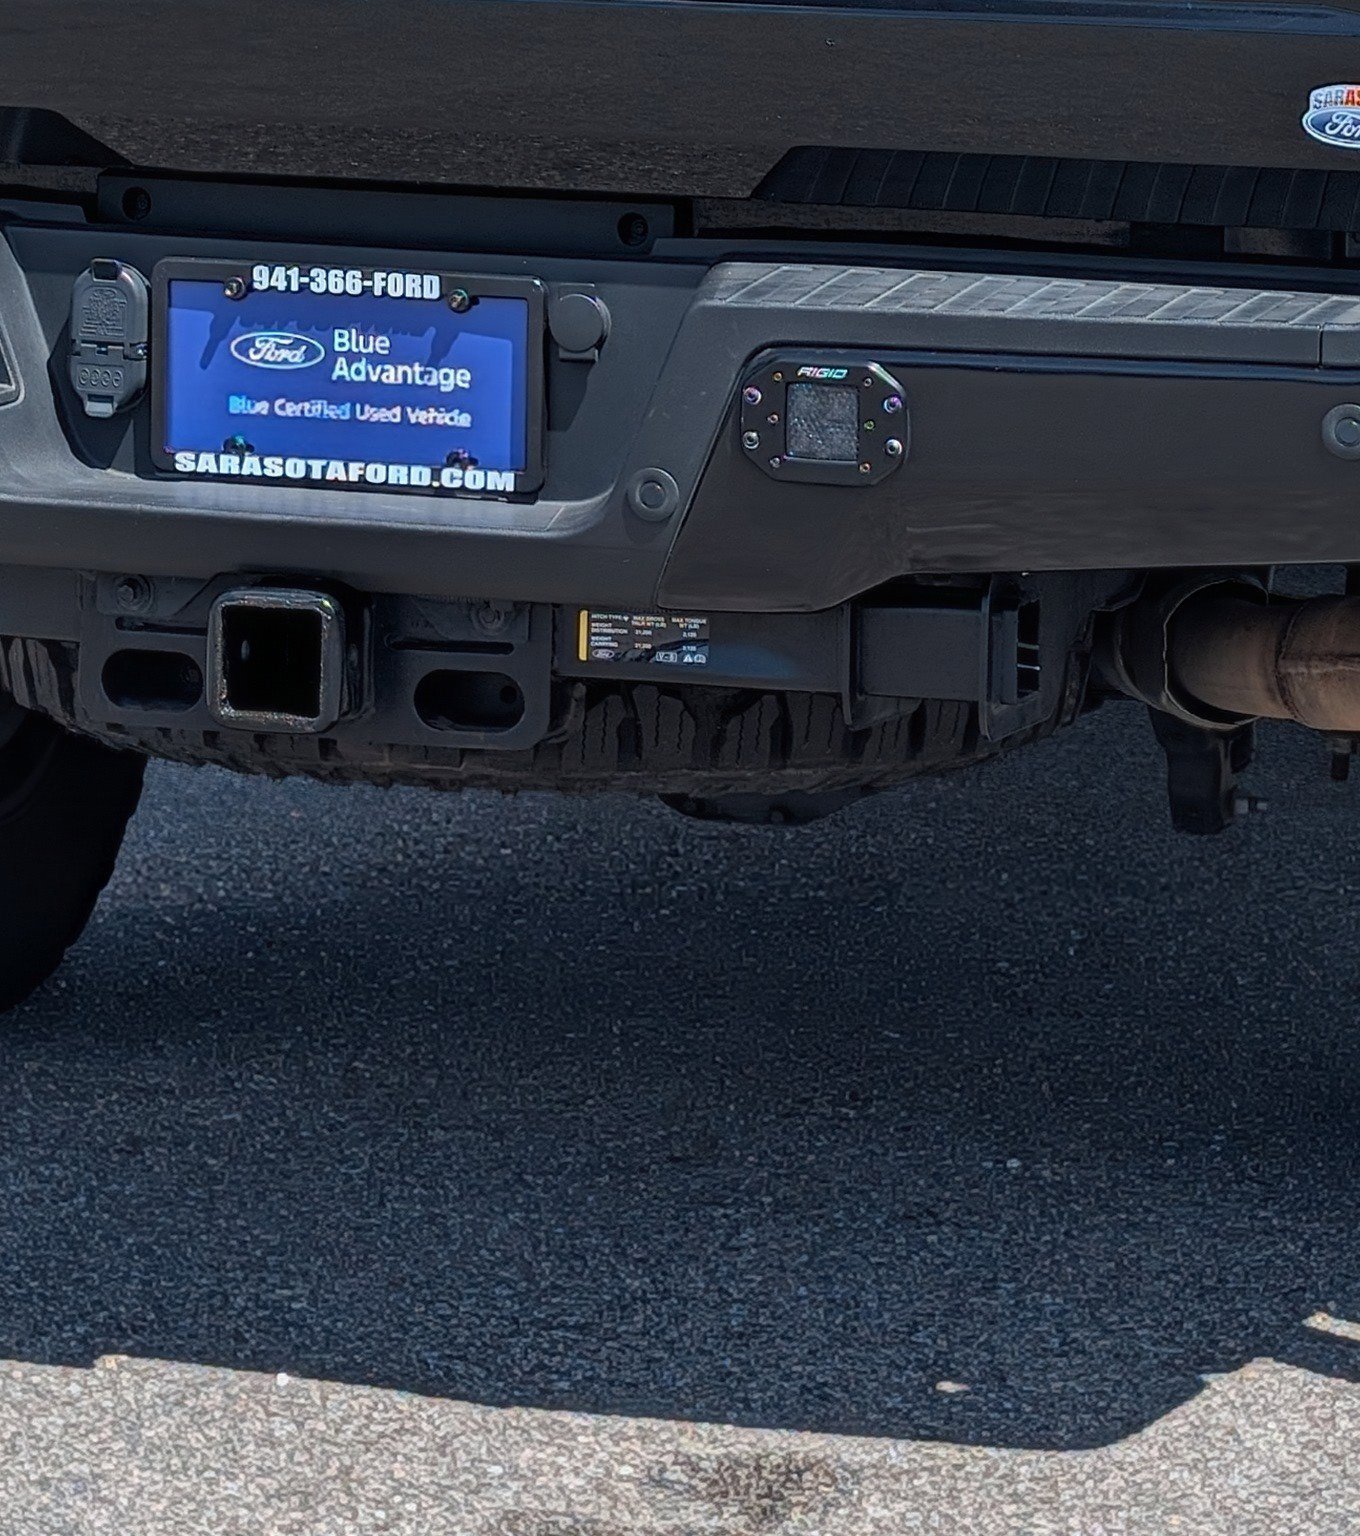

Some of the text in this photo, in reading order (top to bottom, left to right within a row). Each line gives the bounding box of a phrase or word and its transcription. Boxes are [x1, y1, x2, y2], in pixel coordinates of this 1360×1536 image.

[253, 264, 441, 300] 941-366-FORD
[248, 335, 308, 363] Ford
[333, 329, 390, 354] Blue
[331, 357, 472, 392] Advantage
[798, 366, 848, 379] RIGID
[228, 395, 472, 428] Blue Certified Used Vehicle
[173, 451, 516, 492] SARASOTAFORD.COM
